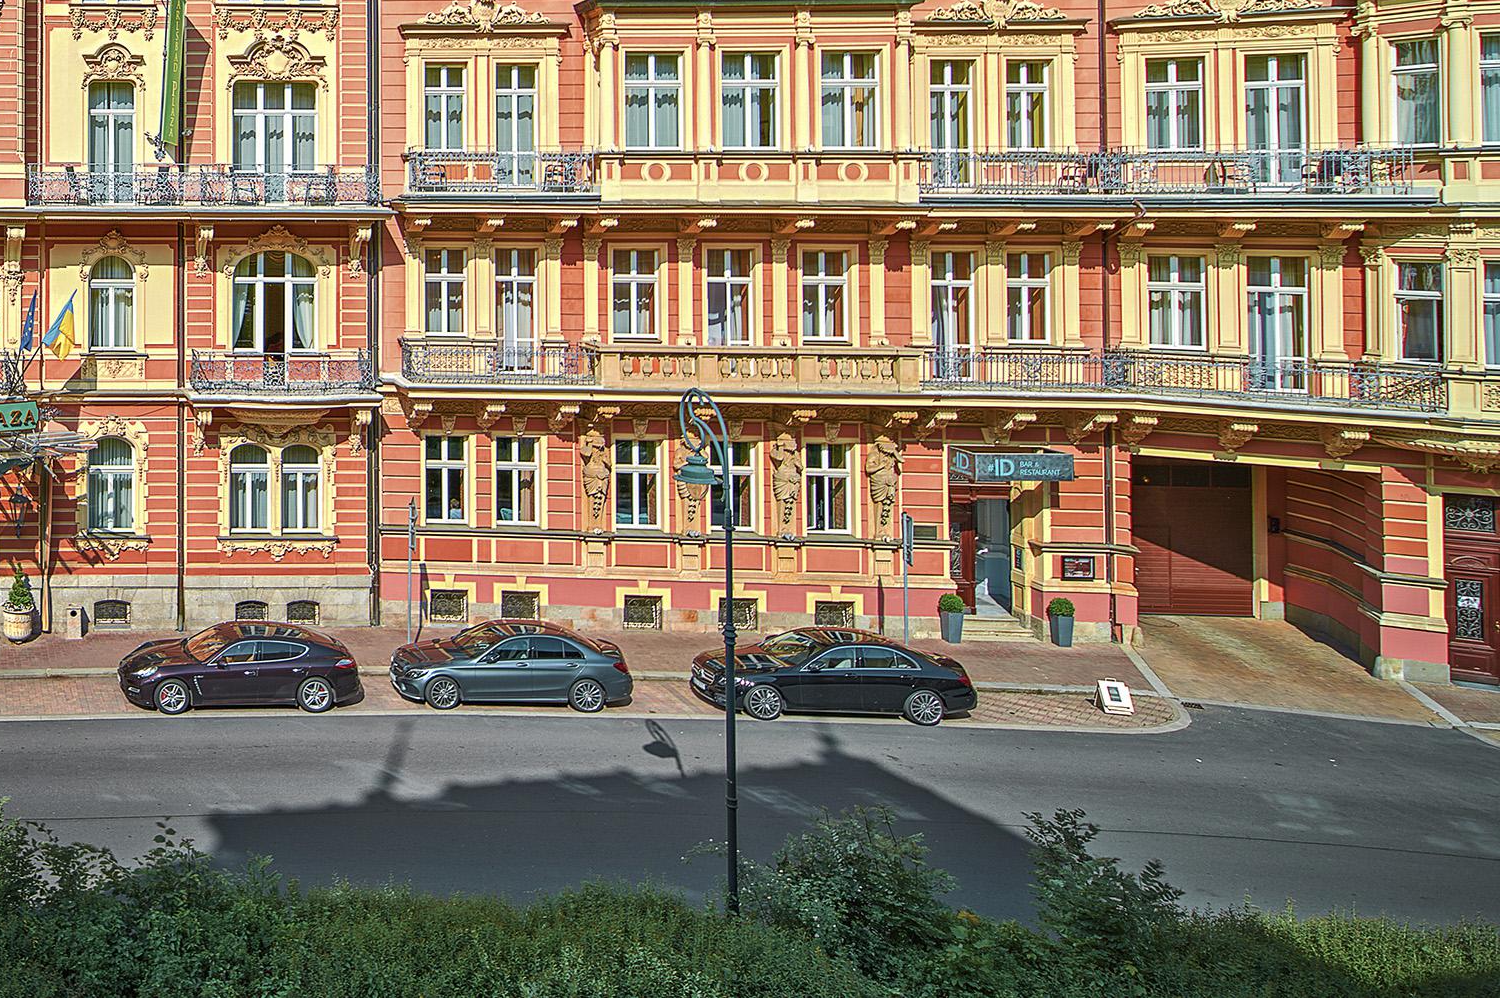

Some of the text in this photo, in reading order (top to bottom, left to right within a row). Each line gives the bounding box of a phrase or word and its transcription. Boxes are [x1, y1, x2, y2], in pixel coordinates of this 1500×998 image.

[169, 80, 178, 137] PLAZA
[987, 459, 1015, 476] #ID
[1019, 460, 1033, 468] BAR
[1019, 468, 1061, 476] RESTAURANT
